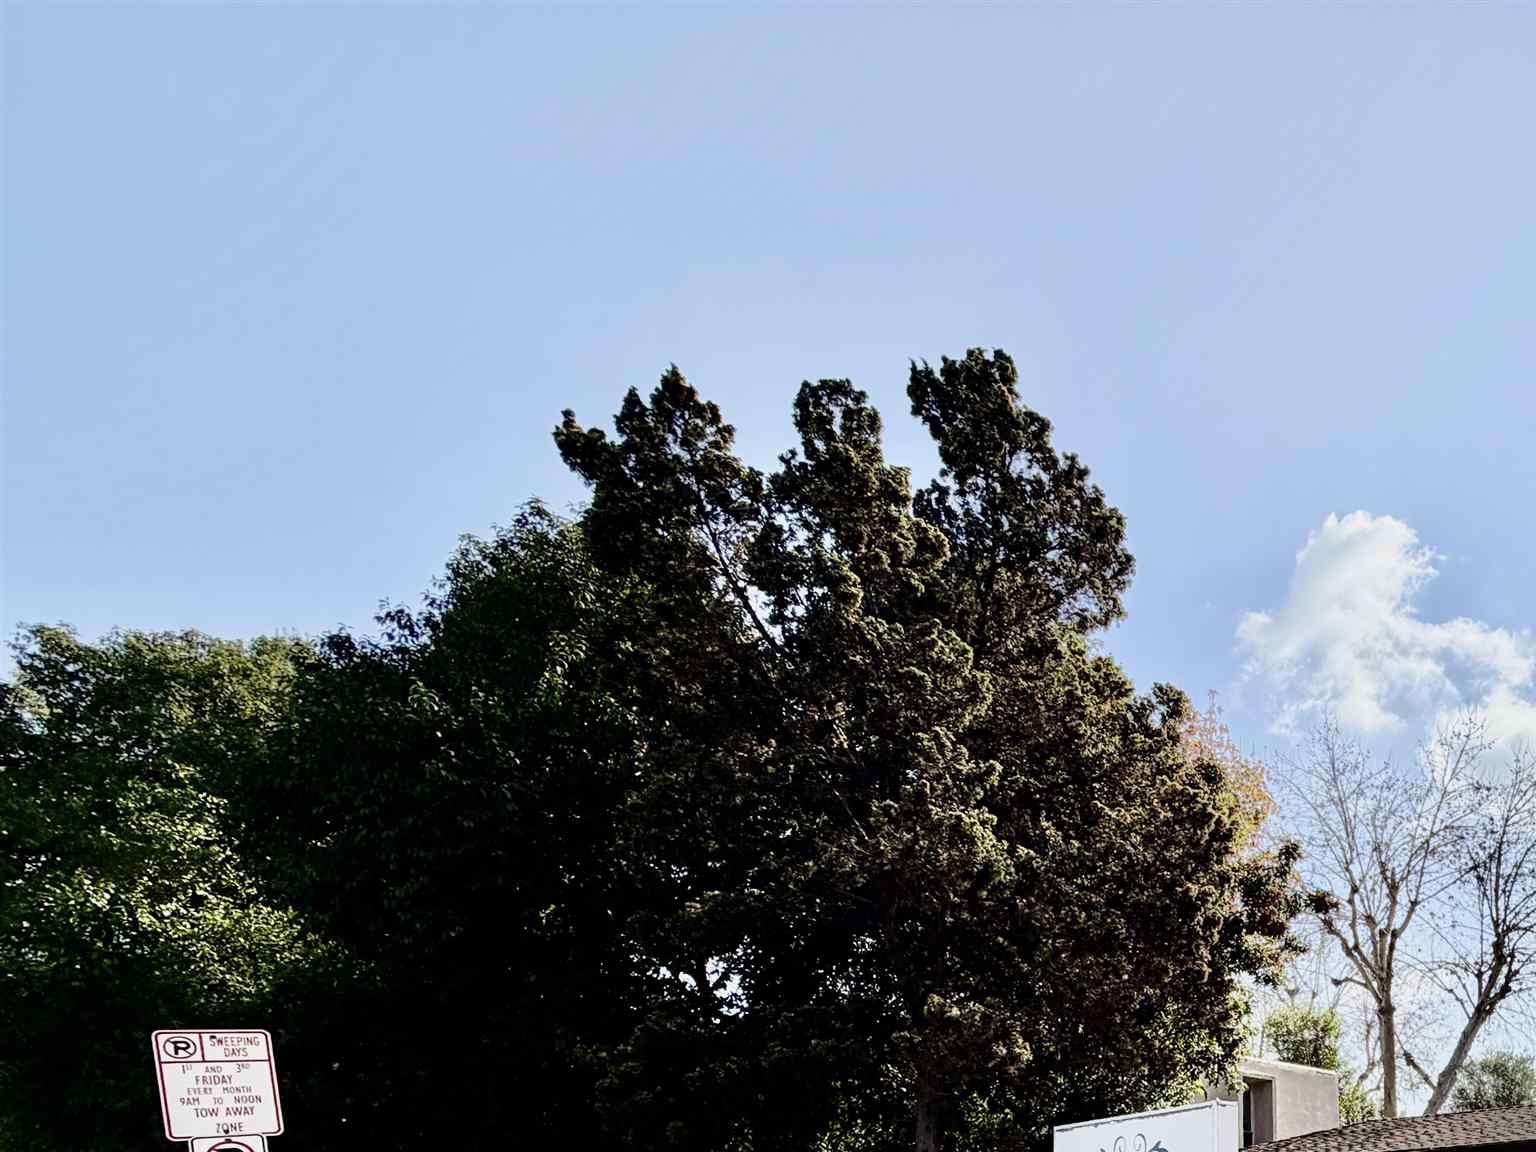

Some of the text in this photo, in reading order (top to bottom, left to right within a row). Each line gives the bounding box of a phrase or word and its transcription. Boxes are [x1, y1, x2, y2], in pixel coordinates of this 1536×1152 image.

[208, 1036, 260, 1047] SWEEPING
[223, 1047, 248, 1057] DAYS
[194, 1075, 233, 1085] FRIDAY
[187, 1086, 252, 1096] EVERY MONTH
[179, 1095, 262, 1106] 9AM TO NOON
[193, 1106, 255, 1118] TOW AWAY
[215, 1122, 244, 1134] ZONE
